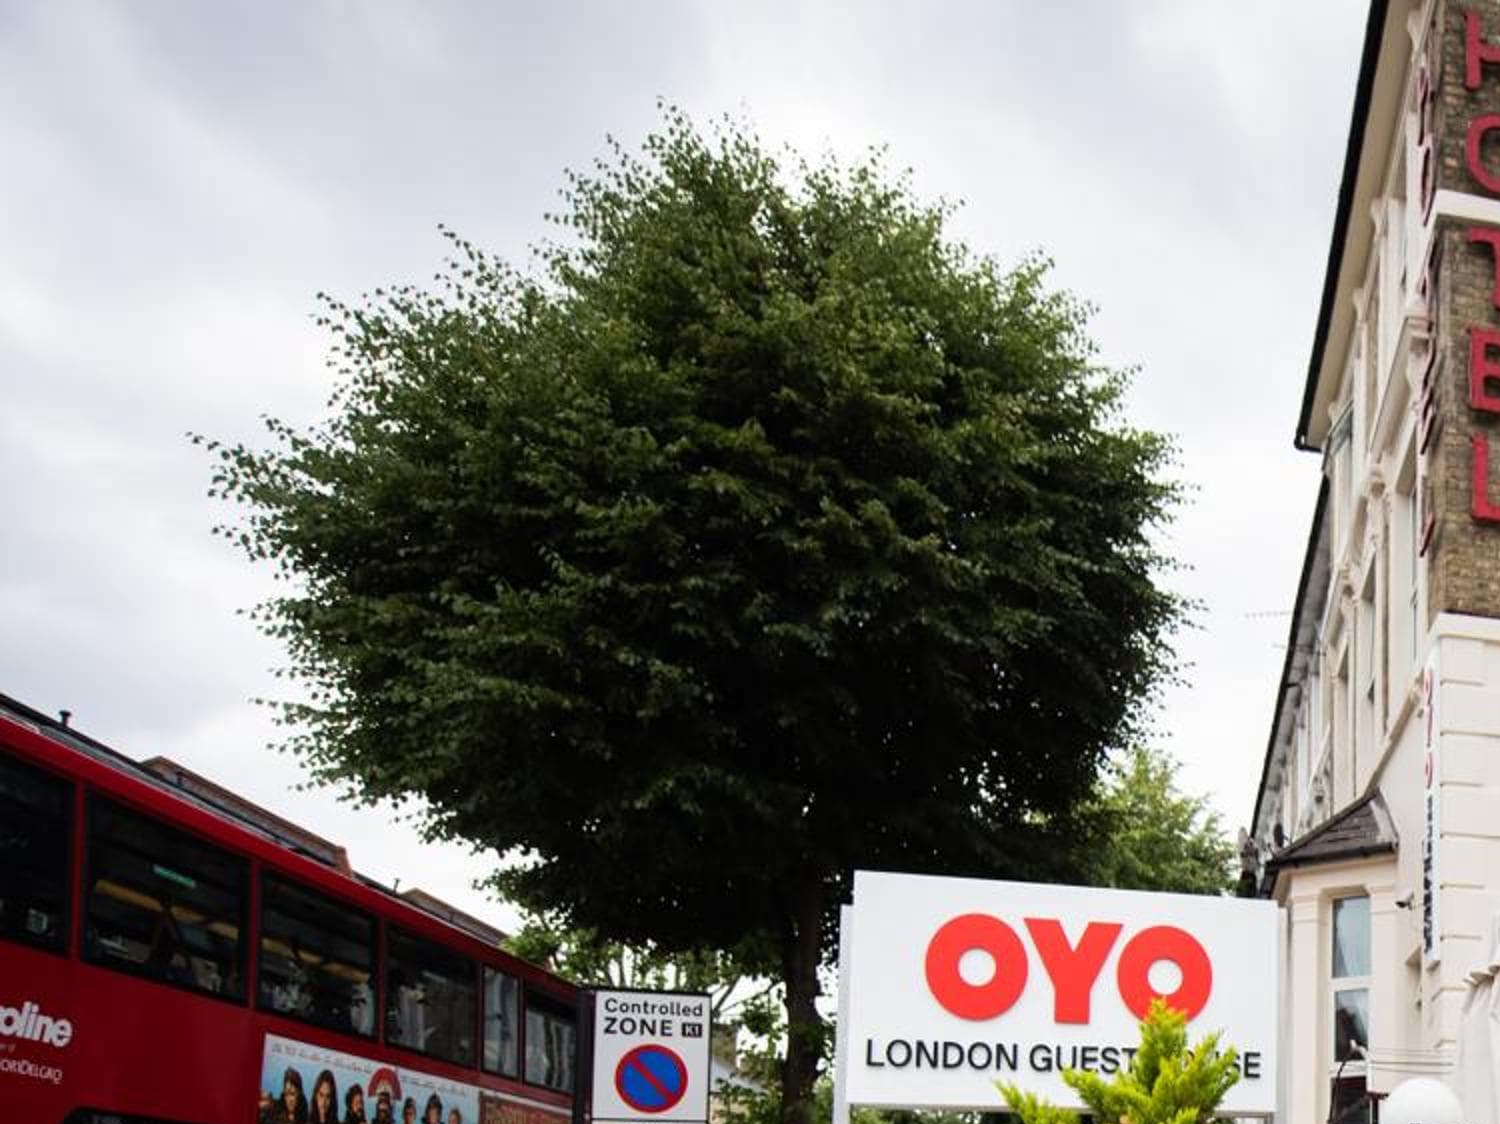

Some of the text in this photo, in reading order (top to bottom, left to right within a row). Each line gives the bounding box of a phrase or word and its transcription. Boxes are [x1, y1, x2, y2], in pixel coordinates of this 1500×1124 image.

[925, 913, 1213, 1025] OYO
[0, 1001, 72, 1047] oline
[604, 998, 703, 1017] Controlled
[604, 1017, 673, 1037] ZONE
[865, 1038, 1018, 1073] LONDON
